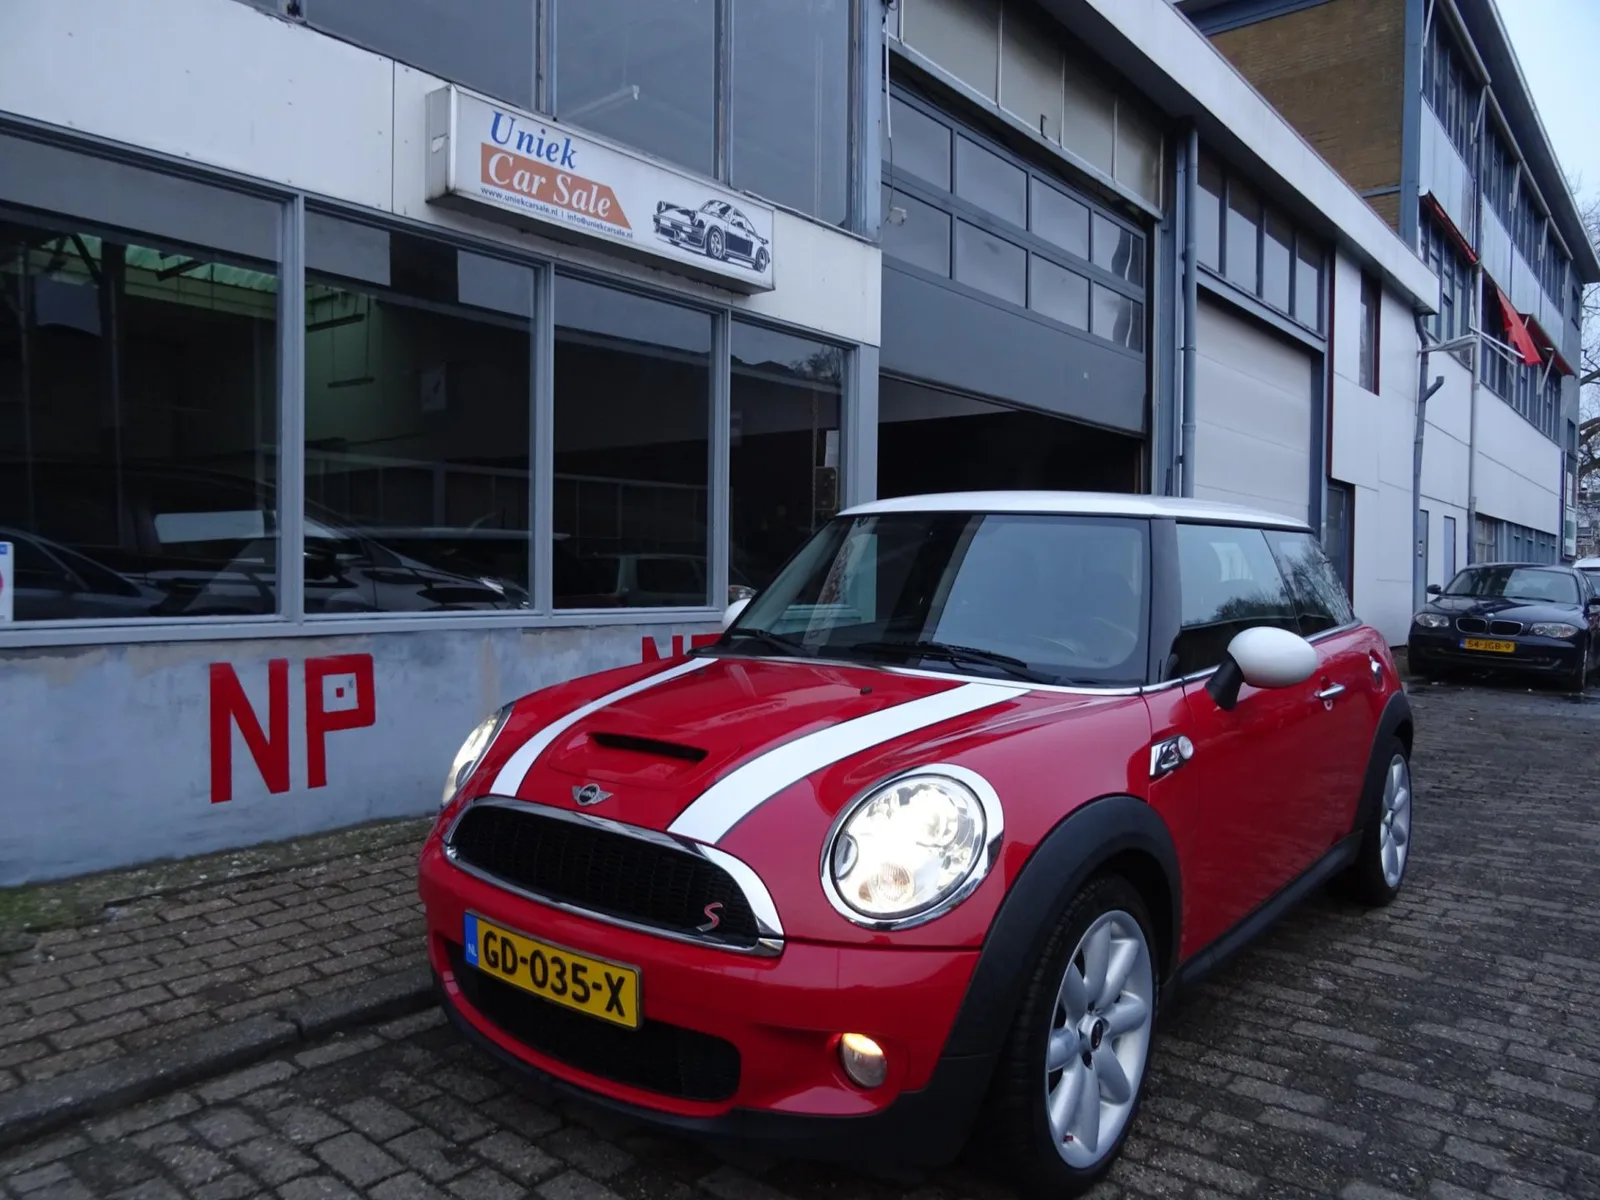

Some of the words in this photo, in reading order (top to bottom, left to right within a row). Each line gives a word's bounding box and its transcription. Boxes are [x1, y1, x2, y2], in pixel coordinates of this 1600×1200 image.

[490, 110, 577, 170] Uniek
[480, 187, 558, 216] www.uniekcarsale.nl
[567, 212, 633, 239] info@uniekcarsale.nl
[488, 152, 547, 198] Car
[553, 173, 611, 218] Sale
[209, 653, 376, 804] NP
[696, 902, 723, 932] S
[483, 930, 626, 1018] GD-035-X
